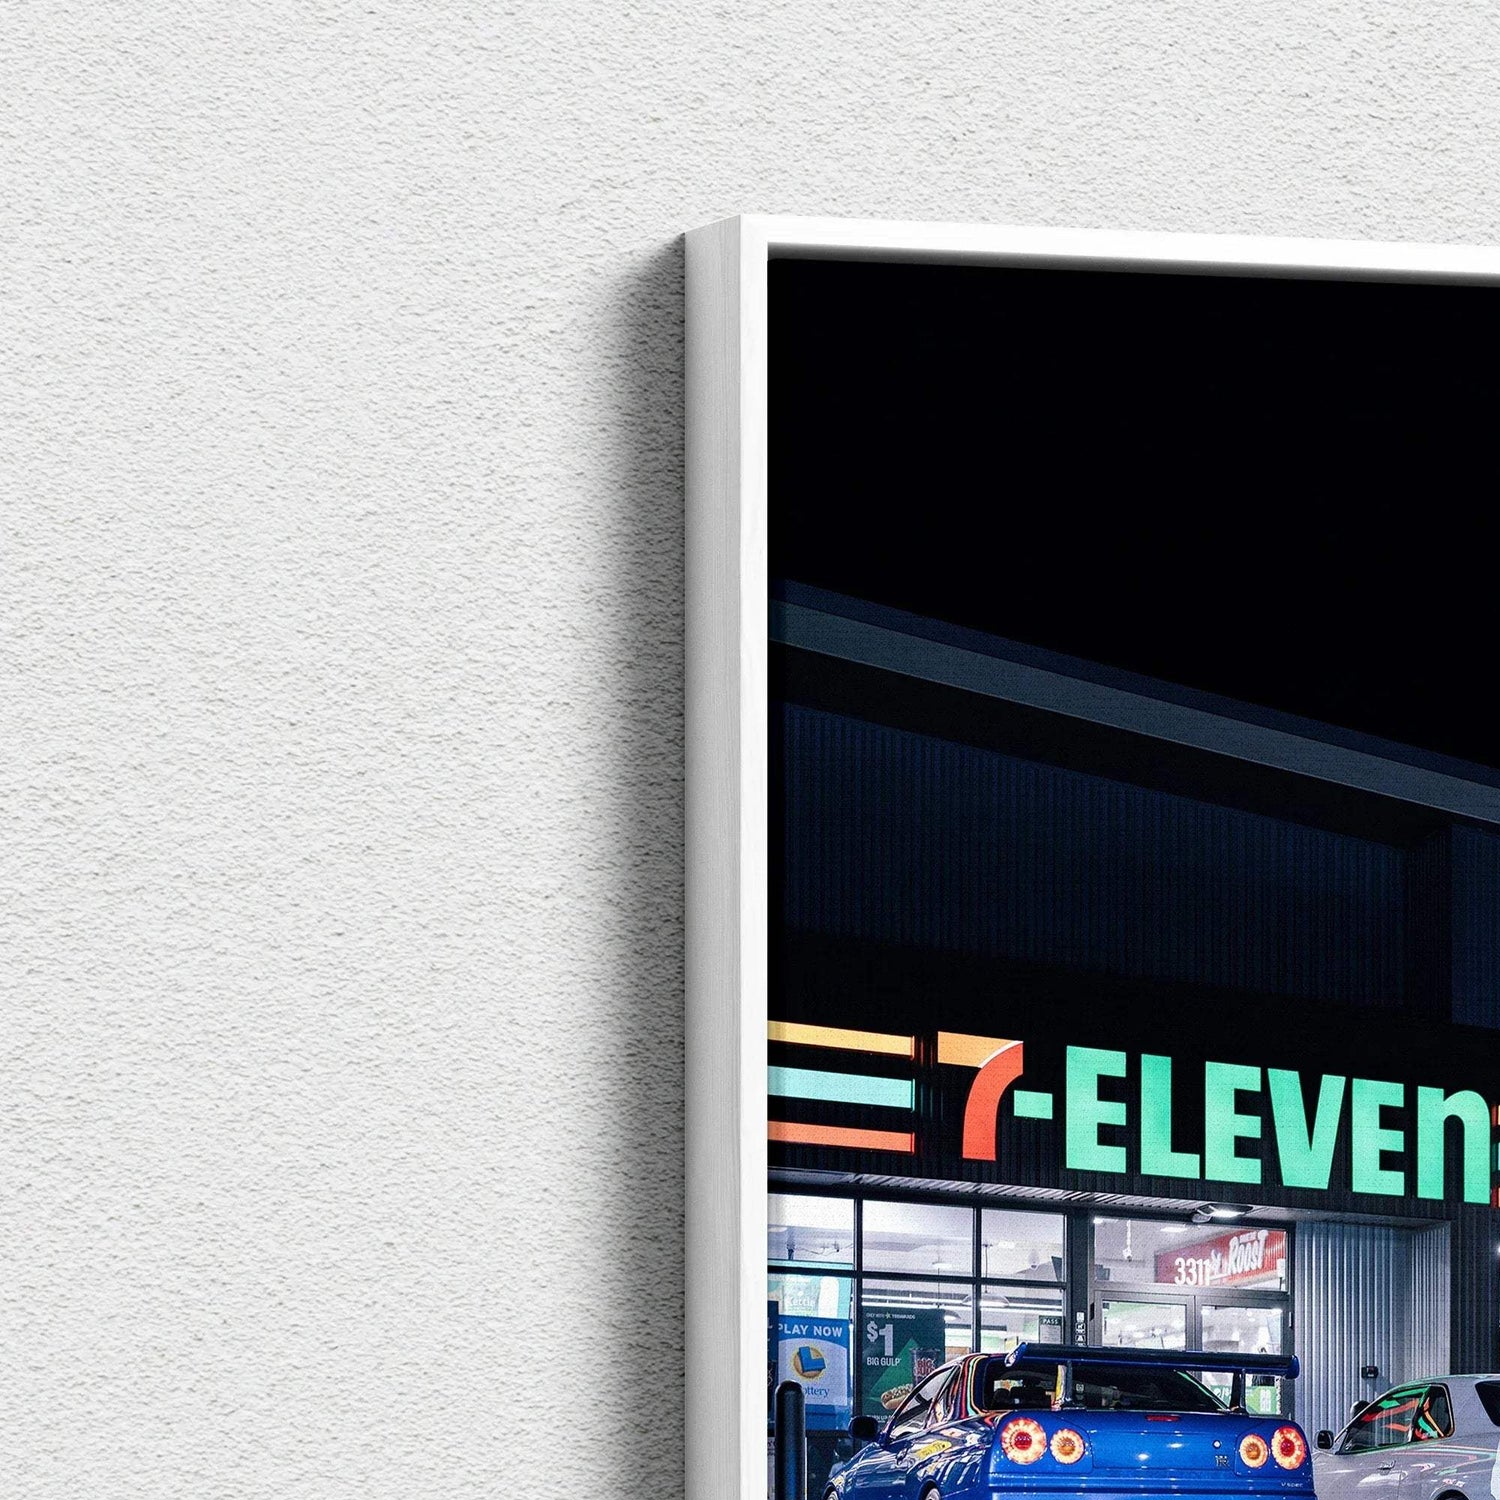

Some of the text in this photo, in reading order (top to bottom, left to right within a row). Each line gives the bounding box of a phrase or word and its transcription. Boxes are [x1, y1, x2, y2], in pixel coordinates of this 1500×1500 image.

[1174, 1257, 1210, 1286] 3311
[813, 1325, 842, 1337] NOW
[867, 1321, 894, 1356] $1
[866, 1357, 901, 1367] BIG GULP
